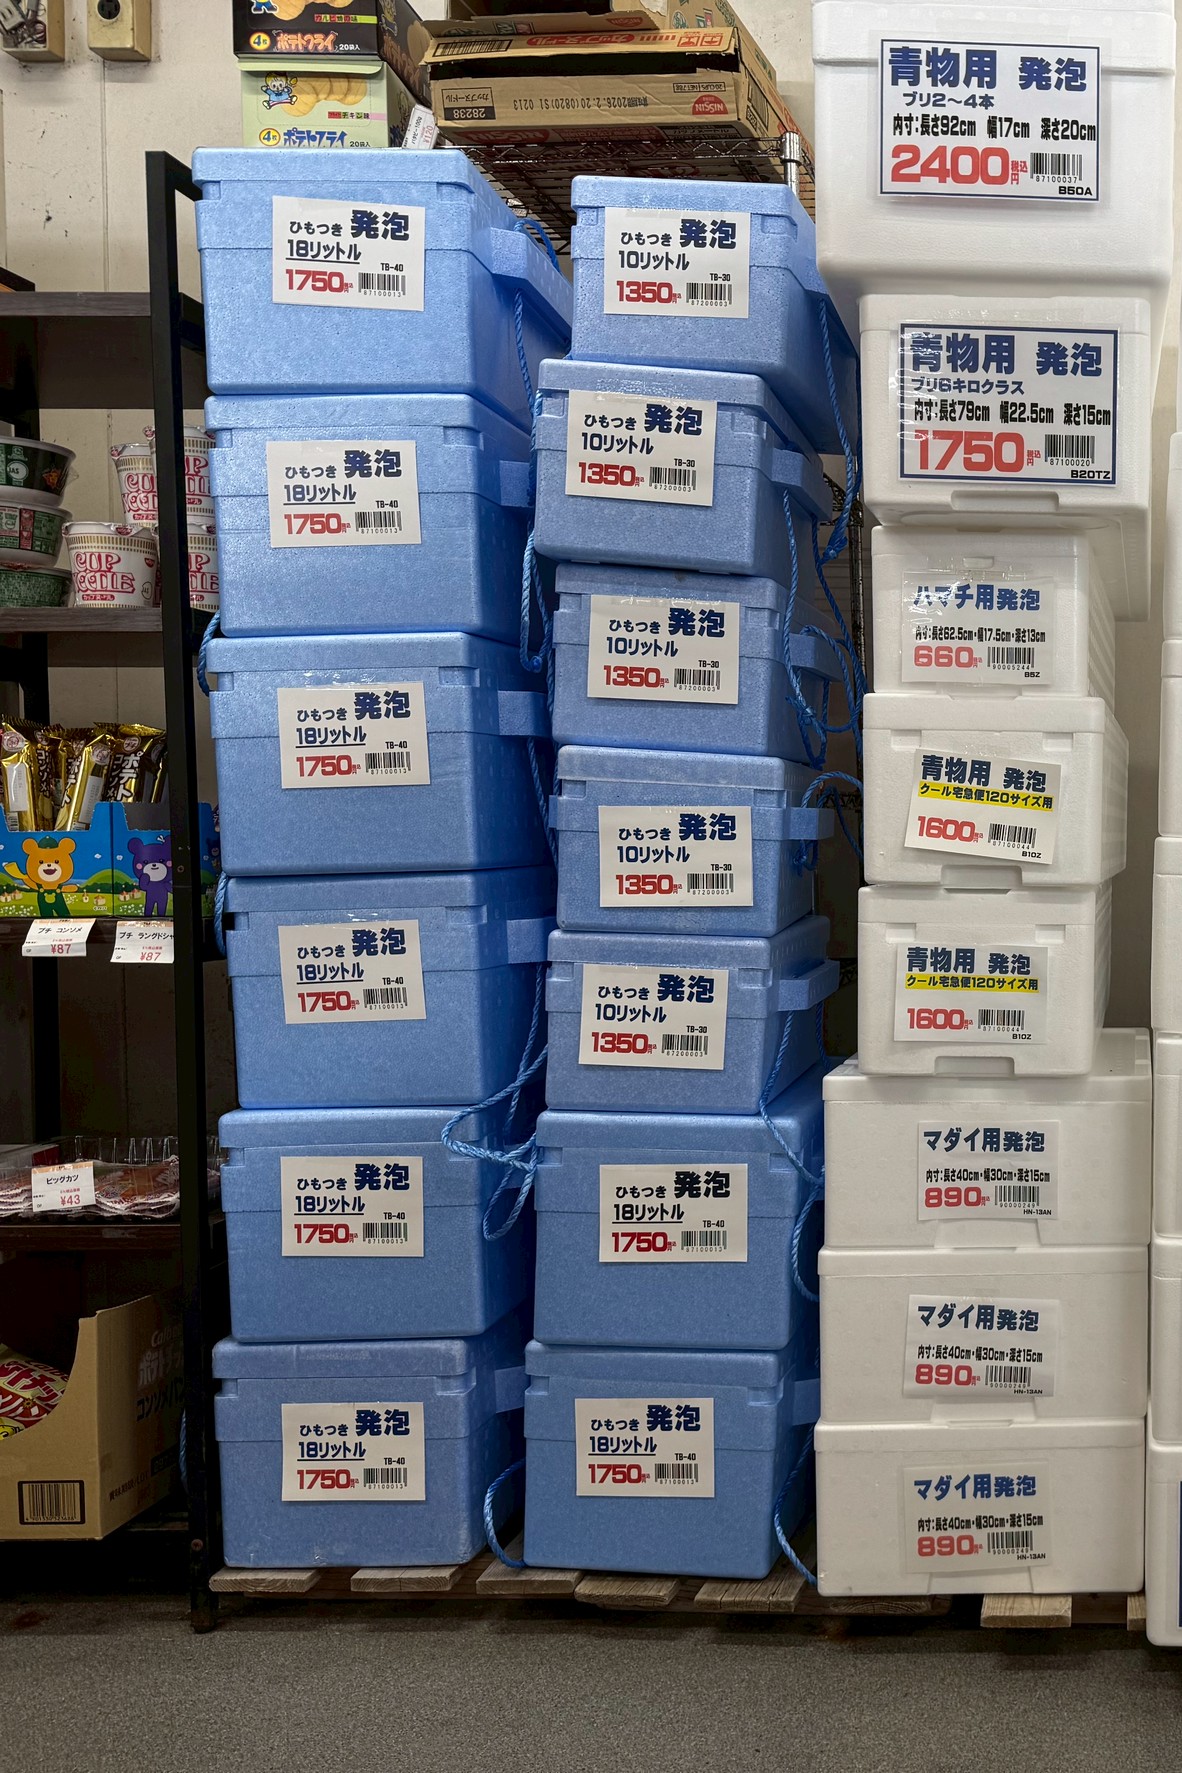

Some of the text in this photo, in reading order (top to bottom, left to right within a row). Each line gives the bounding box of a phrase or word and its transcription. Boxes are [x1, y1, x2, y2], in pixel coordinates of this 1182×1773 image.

[276, 33, 337, 52] ポテトフライ
[889, 46, 1086, 91] 青物用 発泡
[453, 108, 487, 119] 28238
[695, 102, 724, 113] NISSIN
[283, 127, 347, 148] ポテトフライ
[987, 116, 1030, 140] 幅17cm
[1040, 118, 1096, 142] 深さ20cm
[1059, 186, 1092, 196] B50A
[290, 210, 408, 240] ひもつき 発泡
[621, 219, 736, 249] ひもつき 発泡
[287, 238, 362, 262] 18リットル
[619, 250, 689, 270] 10リットル
[380, 263, 404, 272] TB-40
[710, 273, 731, 282] TB-30
[910, 332, 1101, 376] 青物用 発泡
[912, 376, 1024, 394] ブリ6キロクラス
[999, 401, 1054, 425] 幅22.5cm
[1063, 403, 1111, 428] 深さ15cm
[125, 473, 156, 493] CU
[1070, 469, 1111, 479] B20TZ
[75, 552, 122, 572] CUP
[914, 645, 974, 668] 660
[117, 751, 143, 800] ポテト
[921, 755, 1046, 793] 青物用 発泡
[920, 784, 1054, 808] クール宅急便120サイズ用
[619, 813, 736, 840] ひもつき 発泡
[618, 846, 690, 863] 10リットル
[51, 944, 72, 954] ¥87
[140, 952, 161, 961] ¥87
[924, 1128, 1044, 1152] マダイ用発泡
[46, 1174, 79, 1185] ビッグカツ
[60, 1194, 81, 1206] ¥43
[300, 1409, 409, 1436] ひもつき 発泡
[591, 1405, 700, 1431] ひもつき 発泡
[298, 1441, 366, 1459] 18リットル
[589, 1436, 657, 1453] 18リットル
[384, 1457, 405, 1465] TB-40
